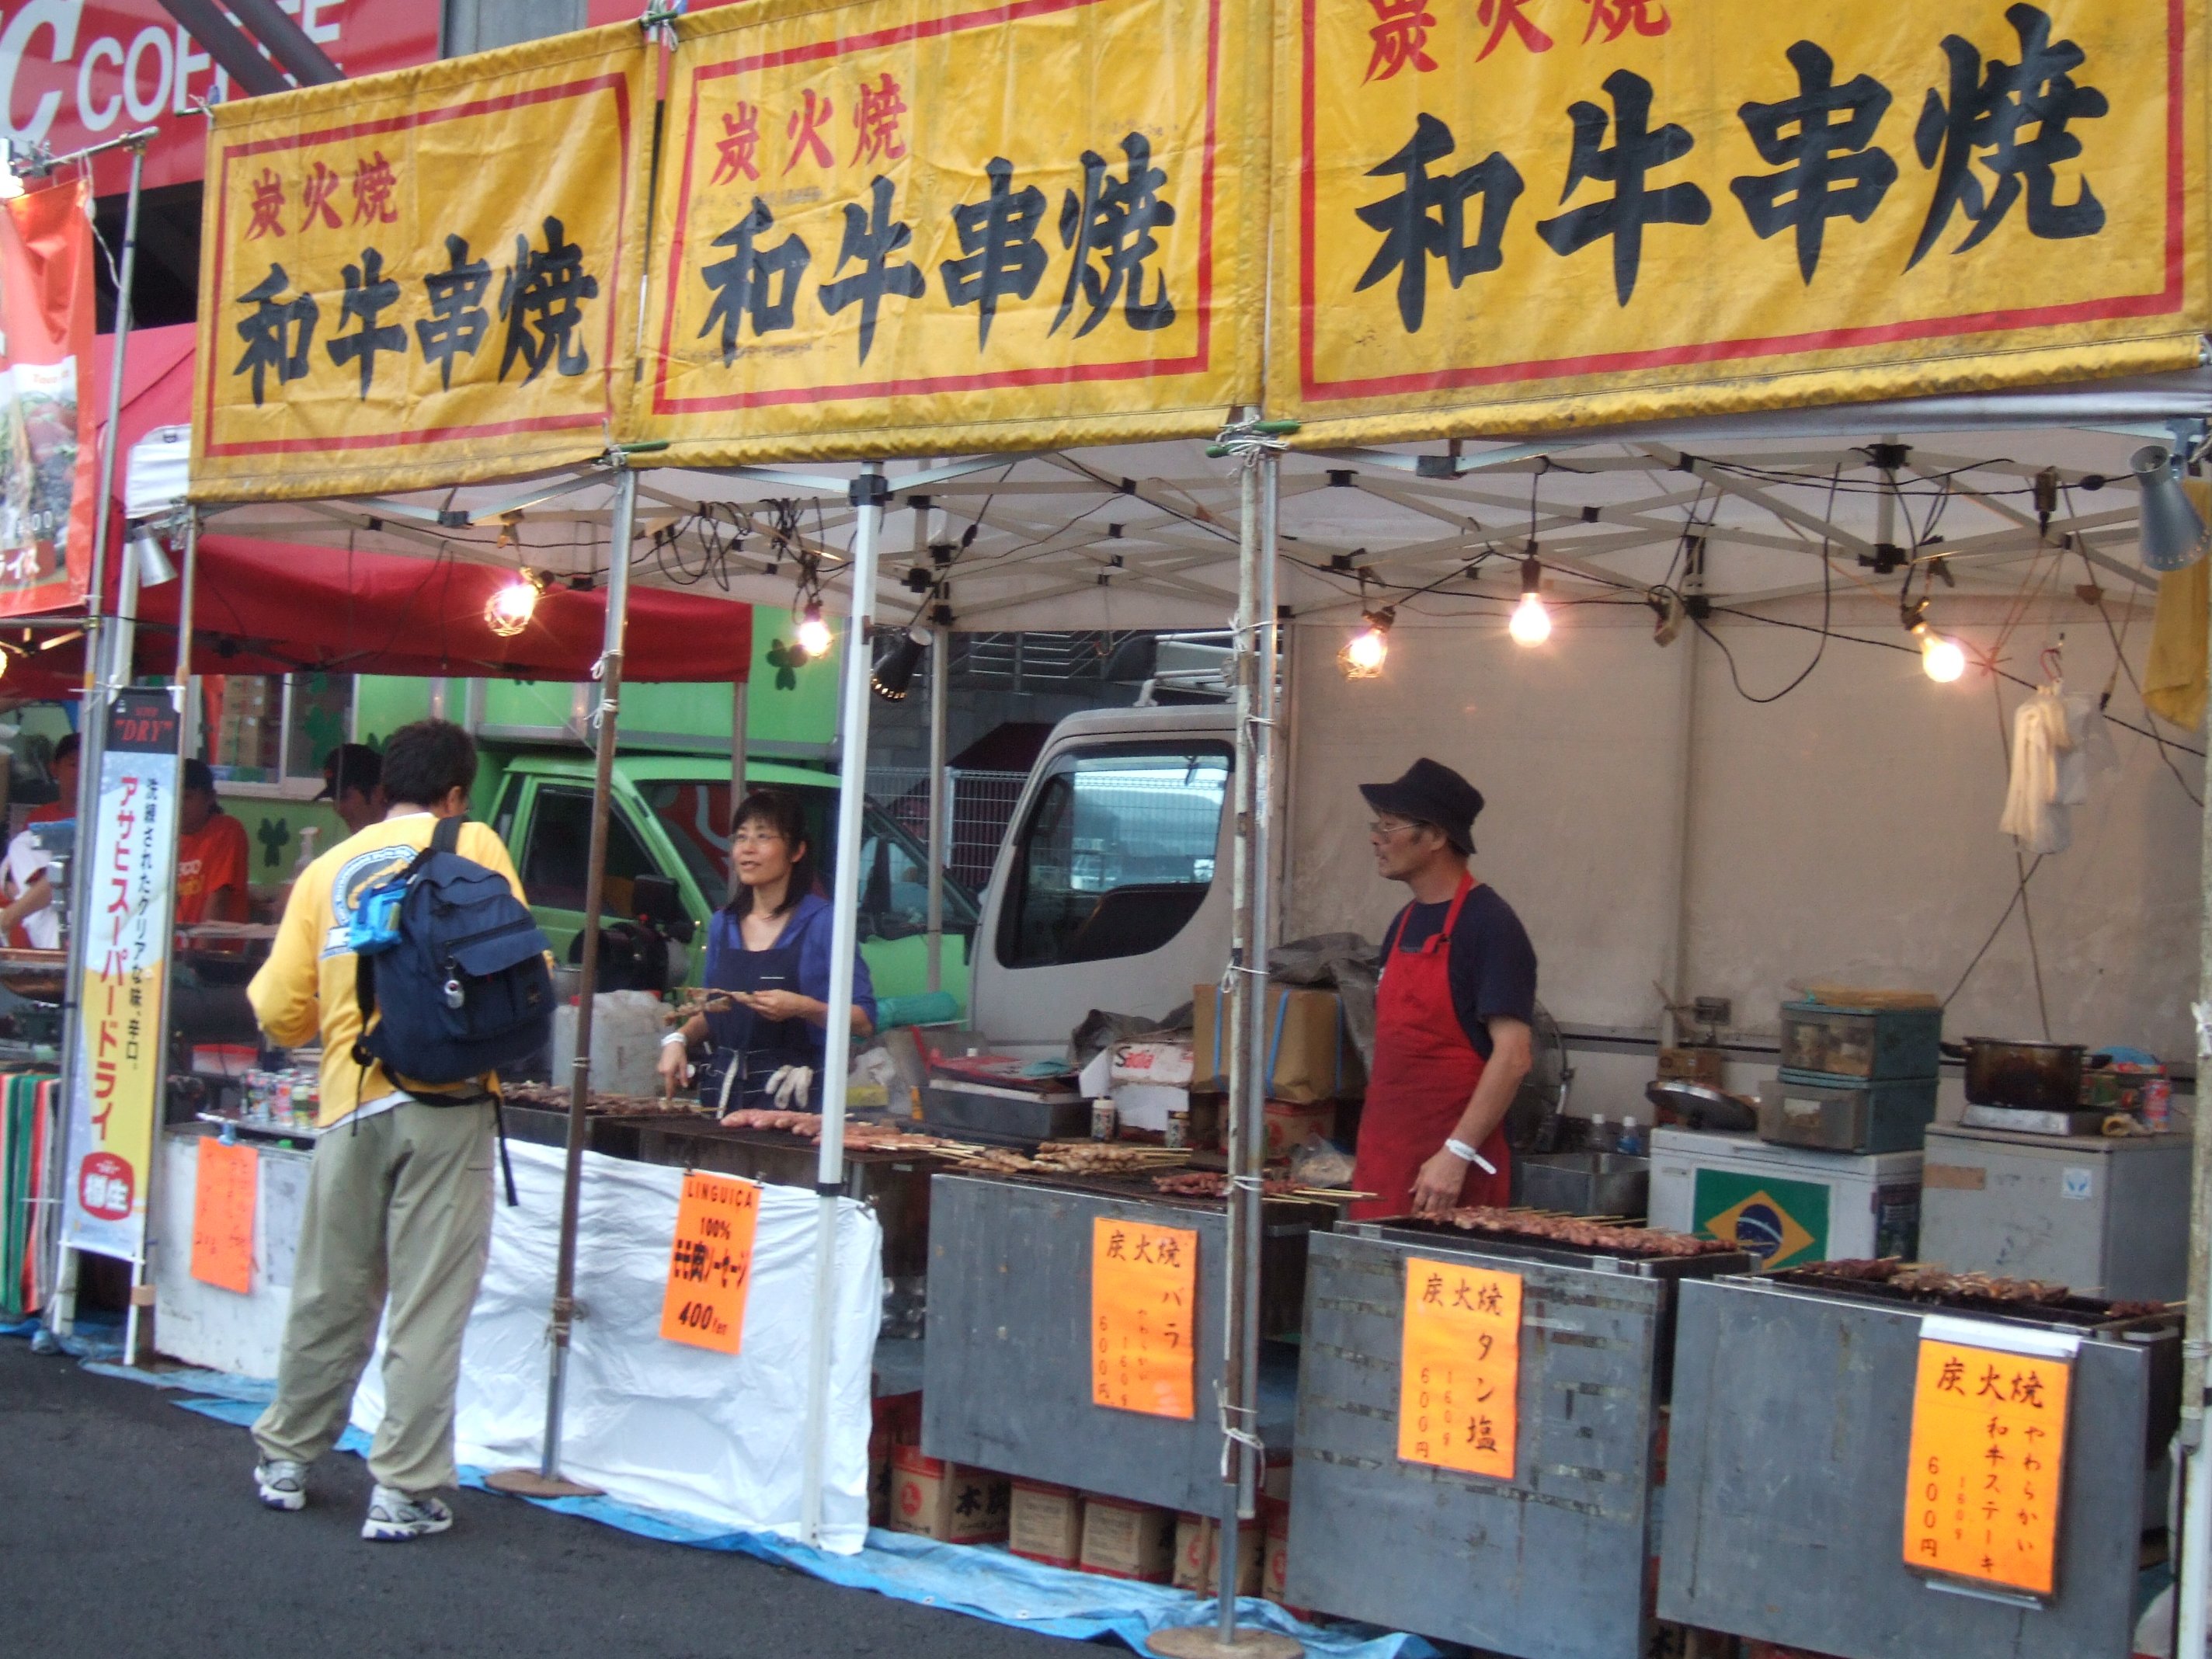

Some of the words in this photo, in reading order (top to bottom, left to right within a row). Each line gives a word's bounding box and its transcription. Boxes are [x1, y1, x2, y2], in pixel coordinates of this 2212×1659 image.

[709, 73, 908, 186] 炭火焼
[1354, 3, 2108, 334] 和牛串焼
[245, 151, 398, 242] 炭火焼
[697, 131, 1176, 369] 和牛串焼
[233, 215, 598, 408] 和牛串焼
[91, 776, 138, 1142] アサヒスーパードライ
[701, 1217, 731, 1240] 100%
[1107, 1229, 1181, 1268] 炭火焼
[678, 1301, 714, 1330] 400
[1162, 1287, 1184, 1349] バラ
[1423, 1272, 1503, 1316] 炭火焼
[1415, 1367, 1430, 1459] 600円
[1466, 1332, 1497, 1453] タン塩
[1936, 1356, 2044, 1409] 炭火焼
[1920, 1455, 1940, 1558] 600円
[1981, 1416, 2009, 1574] 和牛ステーキ
[2017, 1425, 2046, 1552] やわらかい
